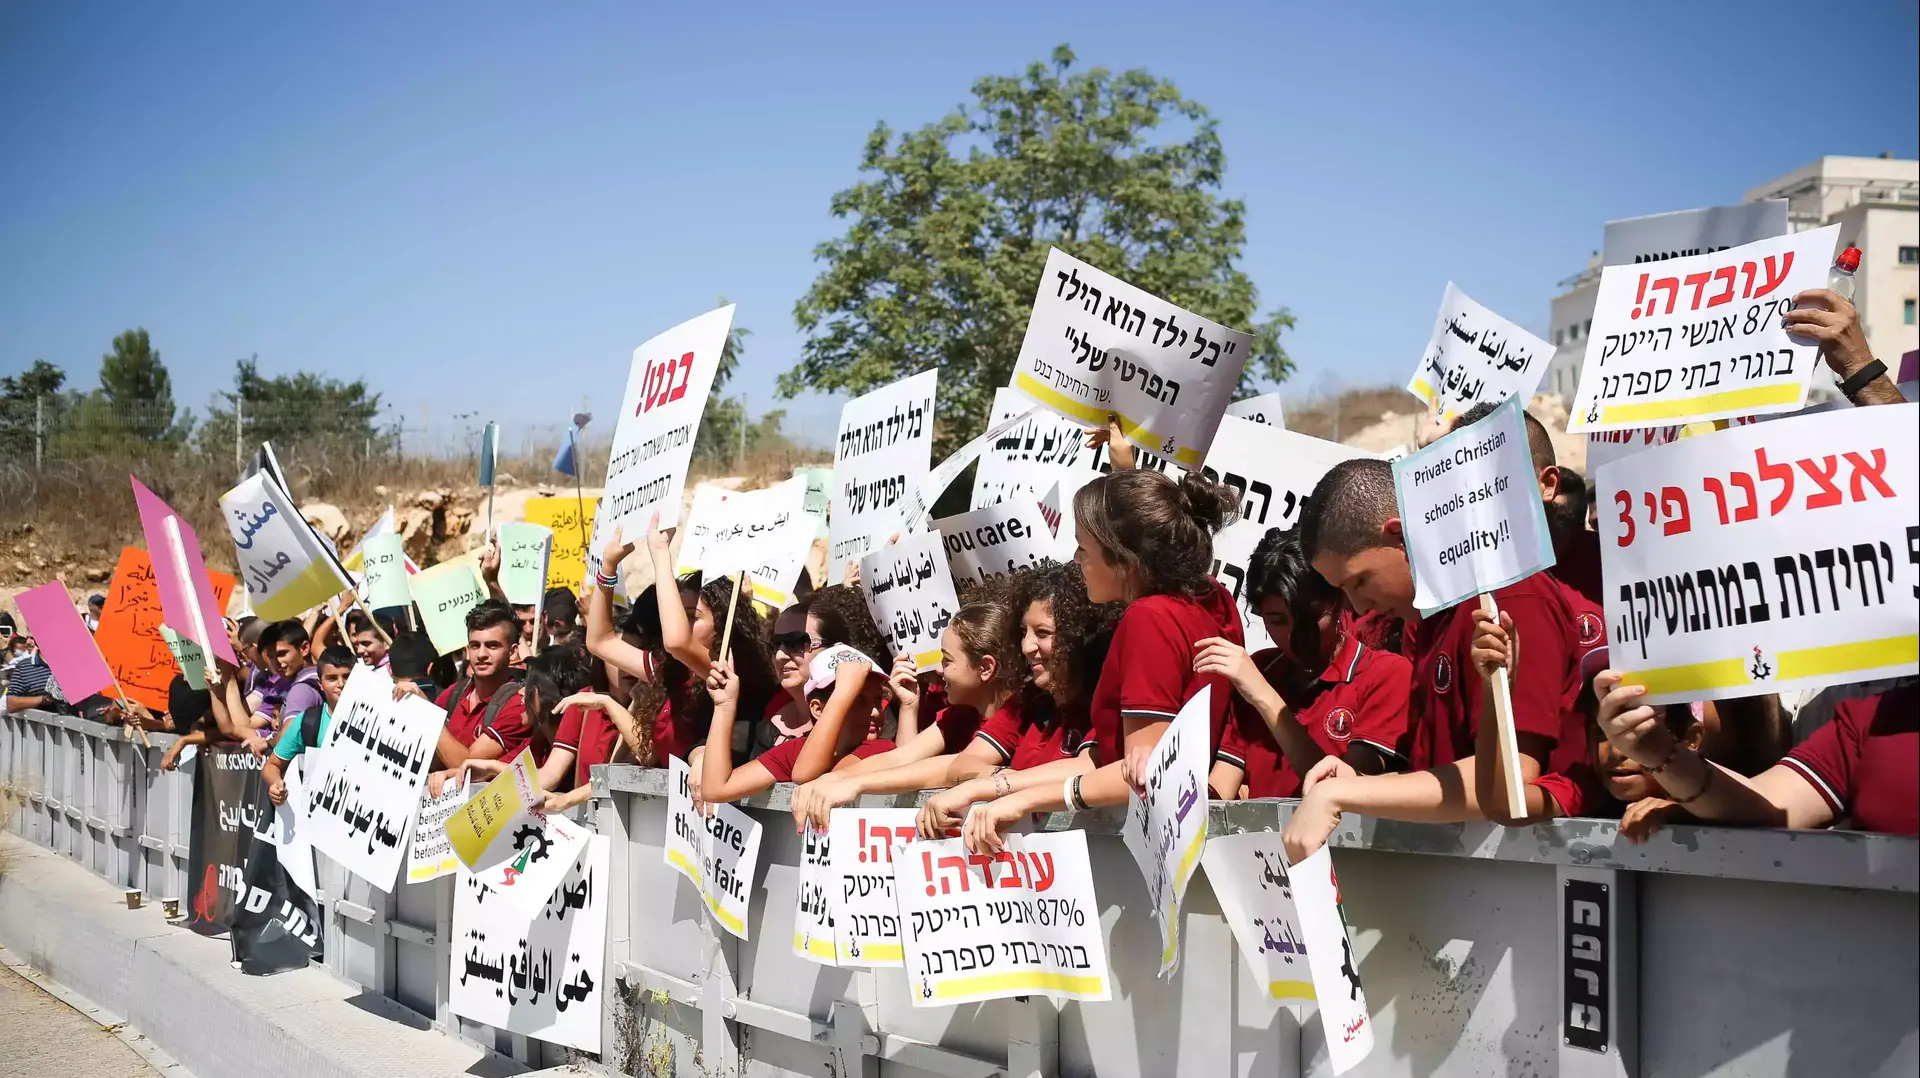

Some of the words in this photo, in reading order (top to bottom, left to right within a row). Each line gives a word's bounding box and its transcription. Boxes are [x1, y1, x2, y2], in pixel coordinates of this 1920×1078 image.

[1056, 268, 1102, 315] הילד
[1630, 251, 1795, 320] עובדה!
[1102, 296, 1146, 337] הוא
[1151, 315, 1188, 348] ילד
[1681, 313, 1738, 348] אנשי
[1065, 326, 1108, 372] שלי"
[1189, 327, 1237, 367] "כל
[1600, 326, 1672, 366] הייטק
[1730, 349, 1794, 381] בוגרי
[635, 352, 694, 417] בנט!
[1034, 358, 1052, 379] בנט
[1055, 369, 1089, 397] החינוך
[1112, 355, 1180, 406] הפרטי
[1593, 368, 1672, 401] ספרנו.
[1681, 361, 1721, 390] בתי
[863, 420, 883, 454] הוא
[887, 405, 904, 446] ילד
[907, 398, 930, 439] "כל
[840, 423, 862, 461] הילד
[1414, 457, 1452, 487] Private
[1454, 430, 1506, 467] Christian
[870, 475, 905, 510] הפרטי
[1424, 493, 1464, 524] schools
[1468, 482, 1493, 504] ask
[1493, 473, 1509, 493] for
[1703, 447, 1897, 525] אצלנו
[233, 501, 277, 549] مش
[1614, 490, 1636, 547] 3
[1644, 486, 1691, 536] פי
[976, 517, 1031, 548] care,
[1438, 519, 1510, 565] equality!!
[1774, 540, 1895, 619] יחידות
[1616, 560, 1770, 659] במתמטיקה.
[216, 754, 228, 770] OUR
[415, 829, 426, 842] be
[714, 858, 745, 903] fair.
[921, 850, 1056, 897] עובדה!
[911, 904, 980, 942] הייטק
[987, 899, 1036, 925] אנשי
[1039, 898, 1085, 928] 87%
[508, 938, 552, 1006] الواقع
[921, 943, 995, 976] ספרנו.
[1004, 941, 1041, 965] בתי
[1041, 943, 1091, 969] בוגרי
[556, 952, 594, 1012] حتى
